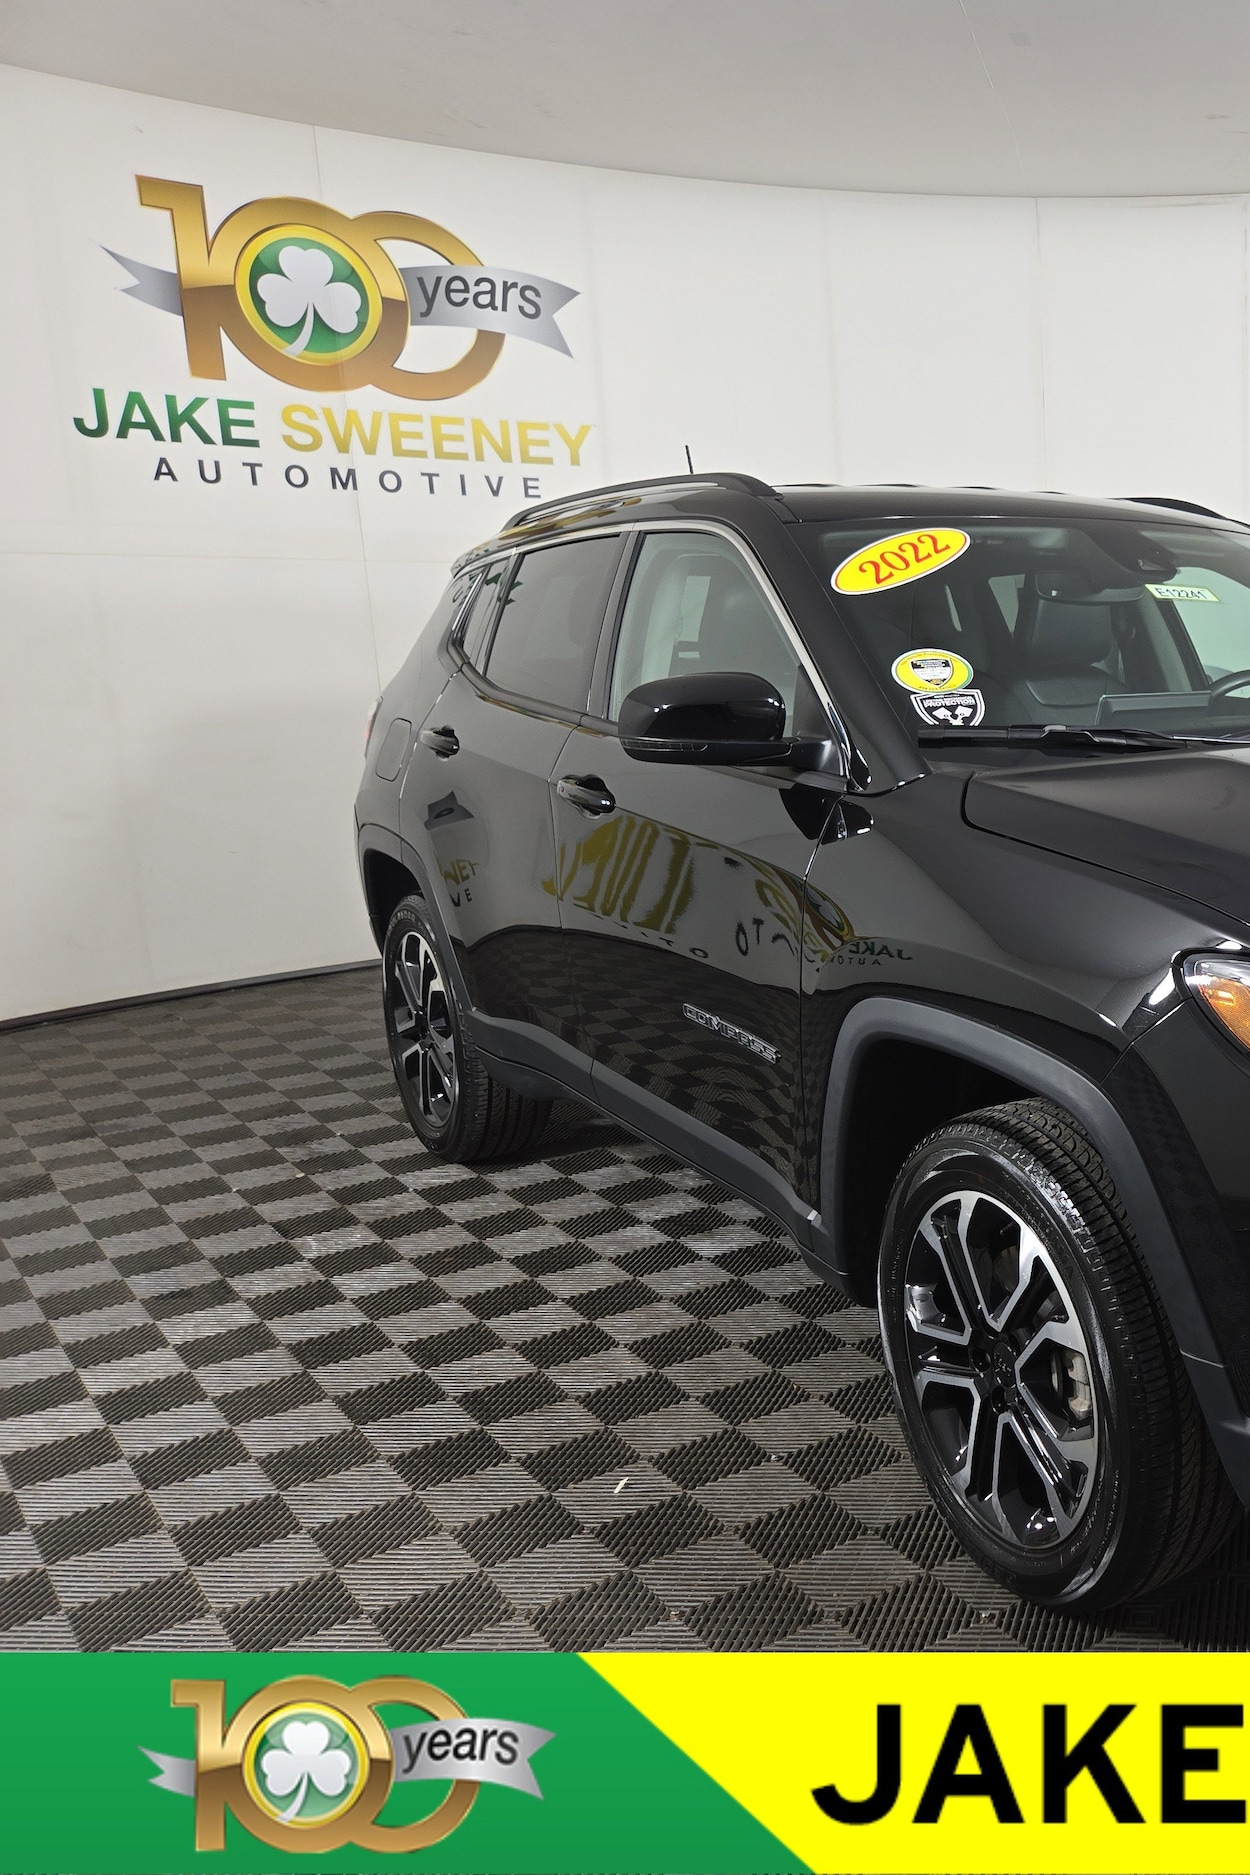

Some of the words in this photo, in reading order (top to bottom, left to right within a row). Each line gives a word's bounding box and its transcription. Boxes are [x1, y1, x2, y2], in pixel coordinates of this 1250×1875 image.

[135, 174, 505, 400] 100
[416, 274, 542, 319] years
[73, 387, 260, 449] JAKE
[281, 403, 592, 466] SWEENEY
[153, 457, 542, 499] AUTOMOTIVE
[858, 534, 951, 584] 2022
[1154, 588, 1208, 600] E12241
[683, 1003, 777, 1065] COMPASS
